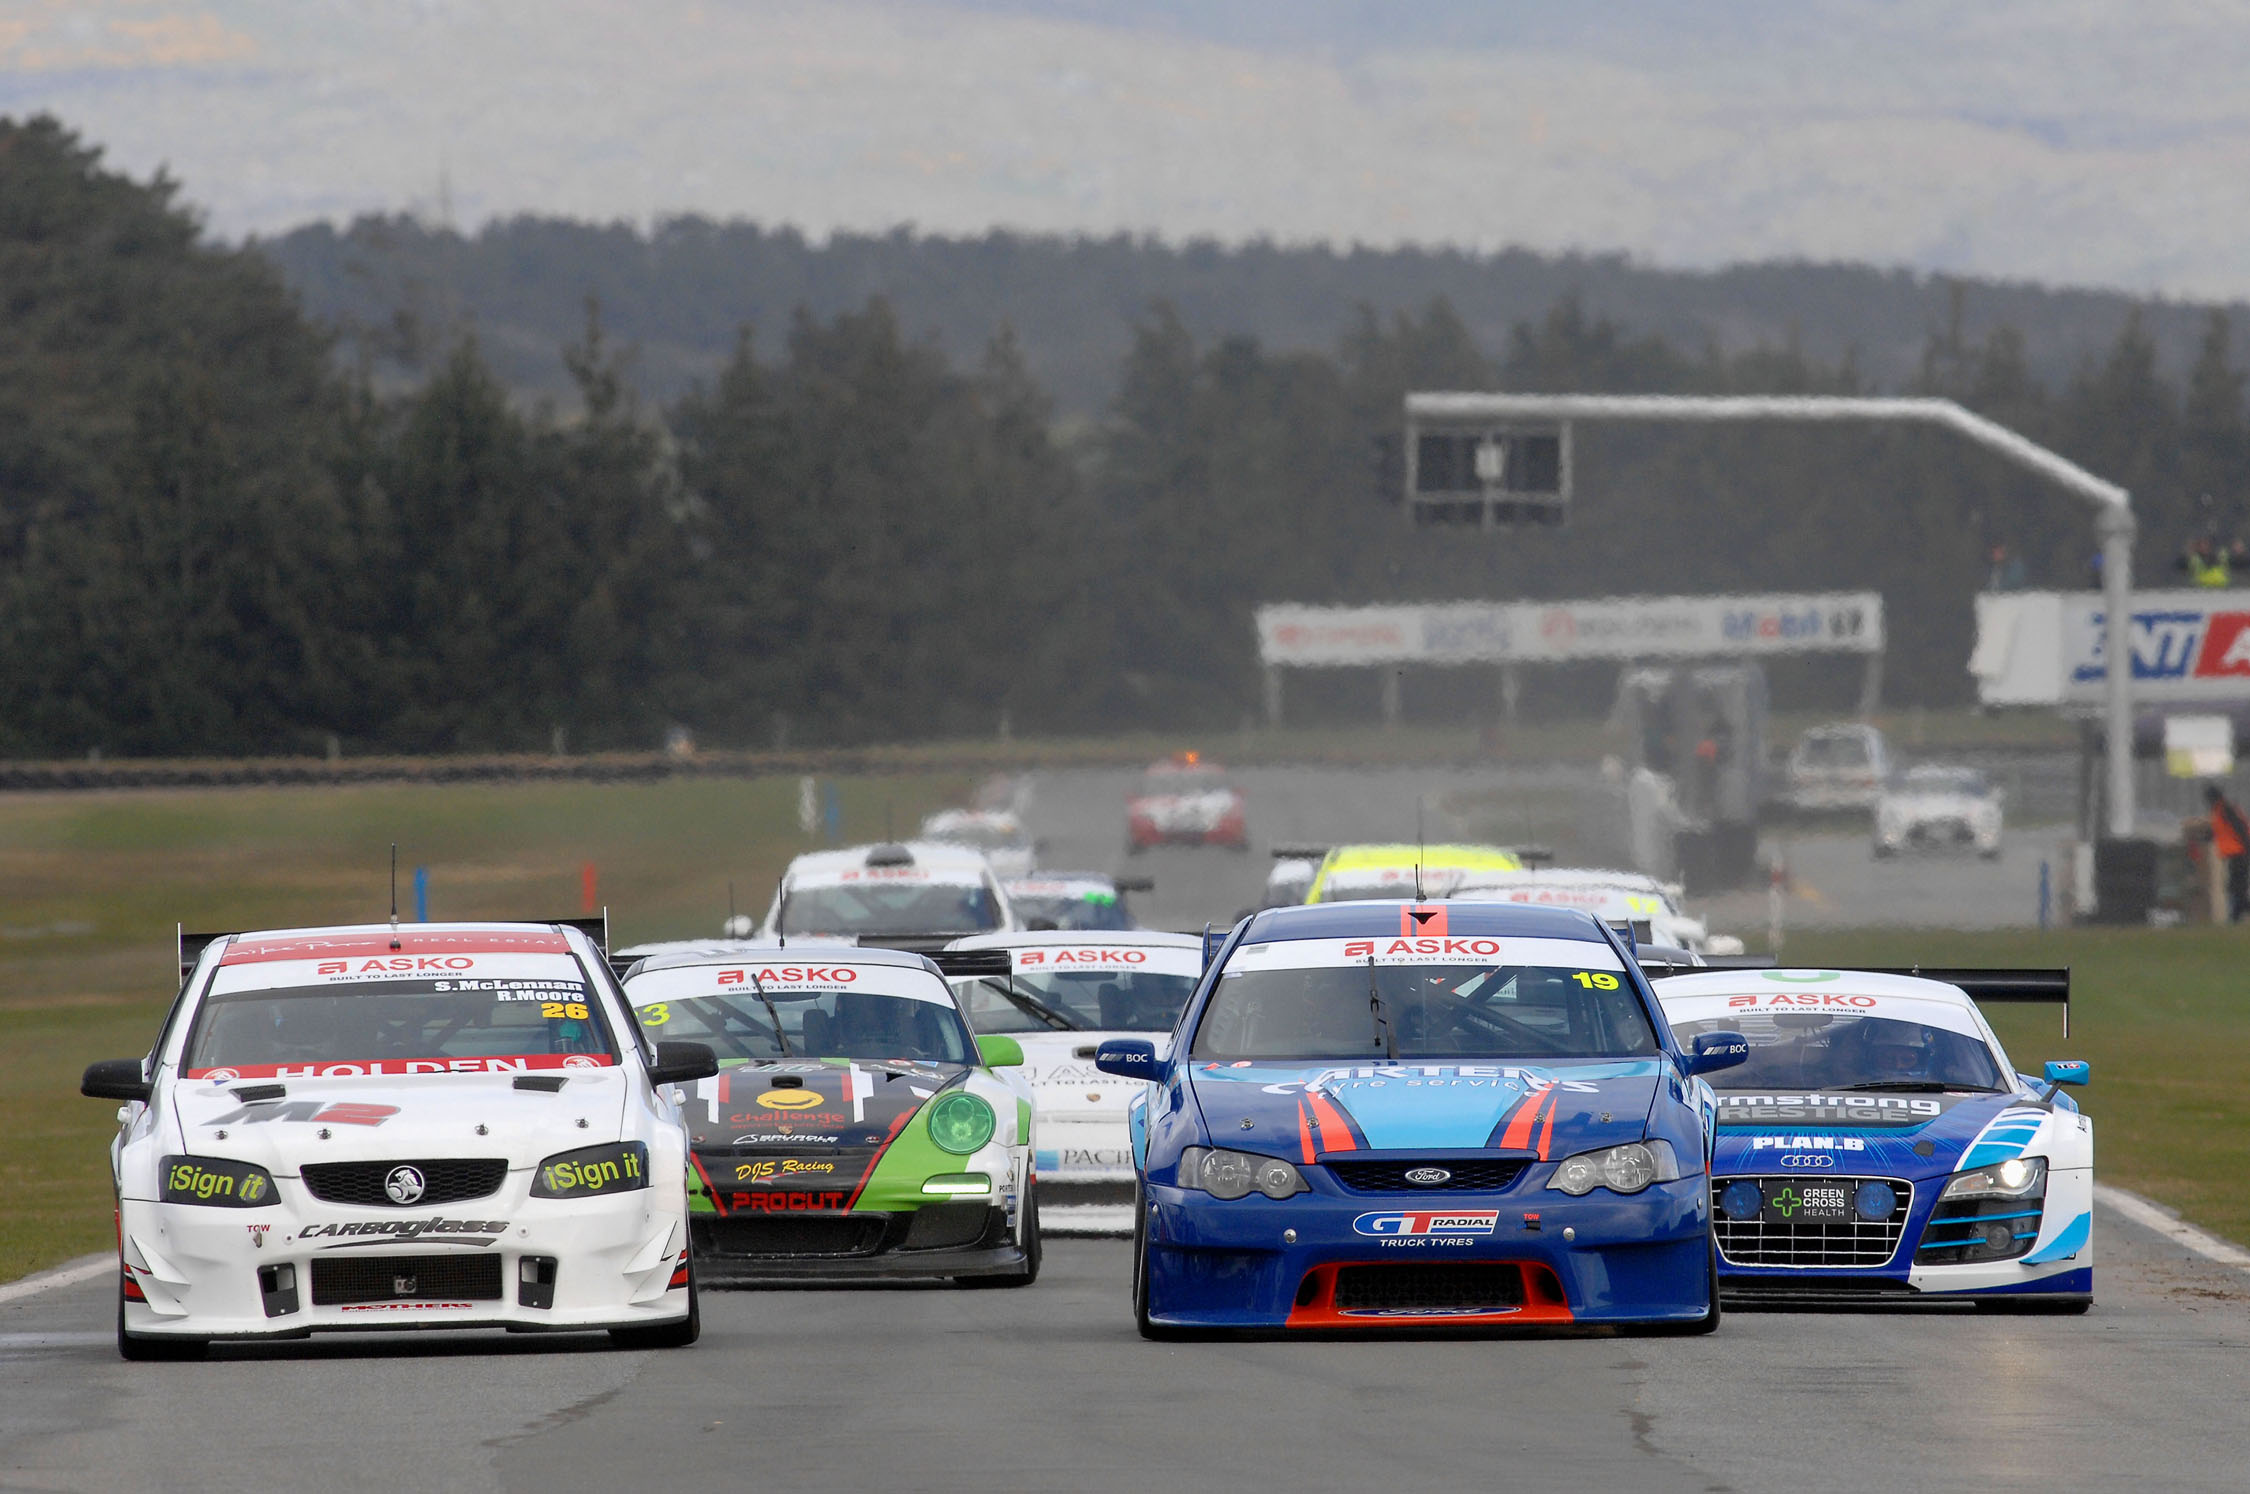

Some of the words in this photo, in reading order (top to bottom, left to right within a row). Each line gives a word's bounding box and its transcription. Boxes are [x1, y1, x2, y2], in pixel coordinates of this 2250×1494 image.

[489, 937, 561, 945] ESTAT
[1386, 939, 1500, 955] ASKO
[1055, 950, 1147, 964] ASKO
[360, 957, 474, 973] ASKO
[329, 974, 362, 982] BUILT
[384, 972, 413, 980] LAST
[757, 967, 857, 982] ASKO
[1571, 971, 1620, 991] 19
[434, 980, 583, 992] S.McLennan
[496, 989, 585, 1002] R.Moore
[1769, 994, 1877, 1008] ASKO
[540, 1002, 589, 1020] 26
[635, 1003, 671, 1026] 3
[1729, 1044, 1747, 1054] BOC
[1126, 1053, 1149, 1063] BOC
[275, 1058, 527, 1079] HOLDEN
[1717, 1093, 1941, 1116] rmstrong
[200, 1101, 402, 1128] M2
[730, 1110, 846, 1125] Challenge
[1718, 1106, 1909, 1122] RESTIGE
[544, 1159, 620, 1190] iSign
[622, 1152, 640, 1178] it
[735, 1161, 777, 1184] DJS
[781, 1159, 835, 1174] Racing
[168, 1164, 234, 1199] iSign
[239, 1173, 264, 1199] it
[1803, 1188, 1845, 1198] GREEN
[732, 1192, 844, 1213] PROCUT
[1803, 1198, 1845, 1208] CROSS
[1804, 1208, 1845, 1217] HEALTH
[247, 1224, 271, 1233] TOW
[1353, 1210, 1434, 1235] GT
[1432, 1218, 1494, 1227] RADIAL
[1380, 1238, 1426, 1248] TRUCK
[1430, 1238, 1474, 1247] TYRES
